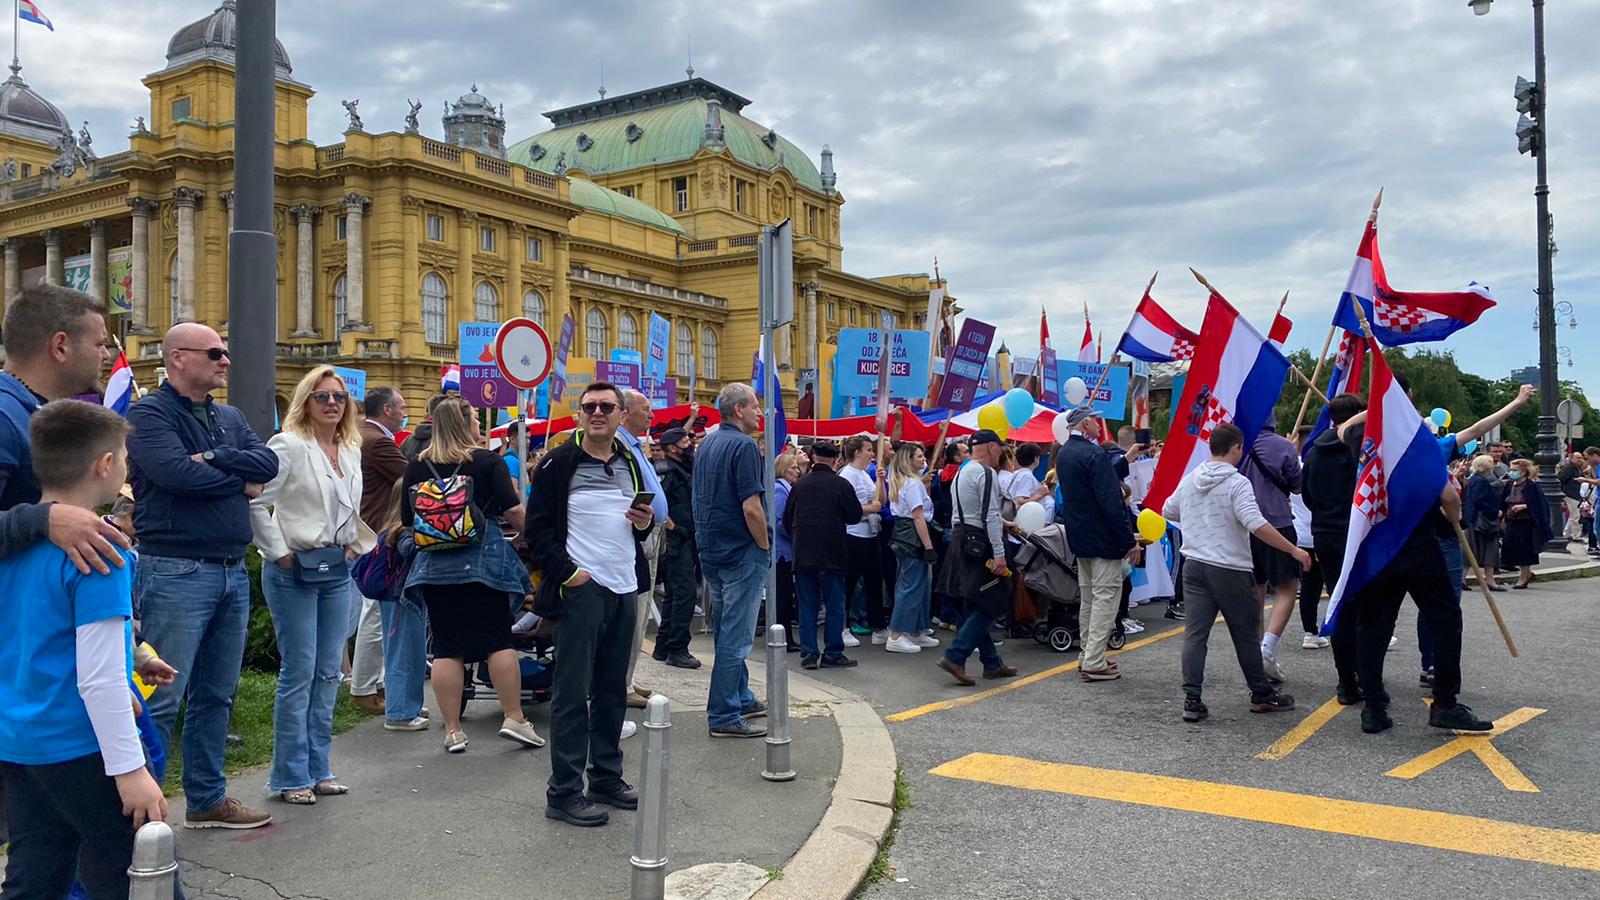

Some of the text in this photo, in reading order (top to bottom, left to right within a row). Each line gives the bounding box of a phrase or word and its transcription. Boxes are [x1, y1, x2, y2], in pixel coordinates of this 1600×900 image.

[465, 327, 480, 337] OVO
[482, 327, 490, 337] JE
[867, 333, 878, 343] 18
[861, 346, 873, 357] OD
[464, 368, 479, 379] OVO
[481, 368, 489, 378] JE
[890, 363, 907, 375] RCE
